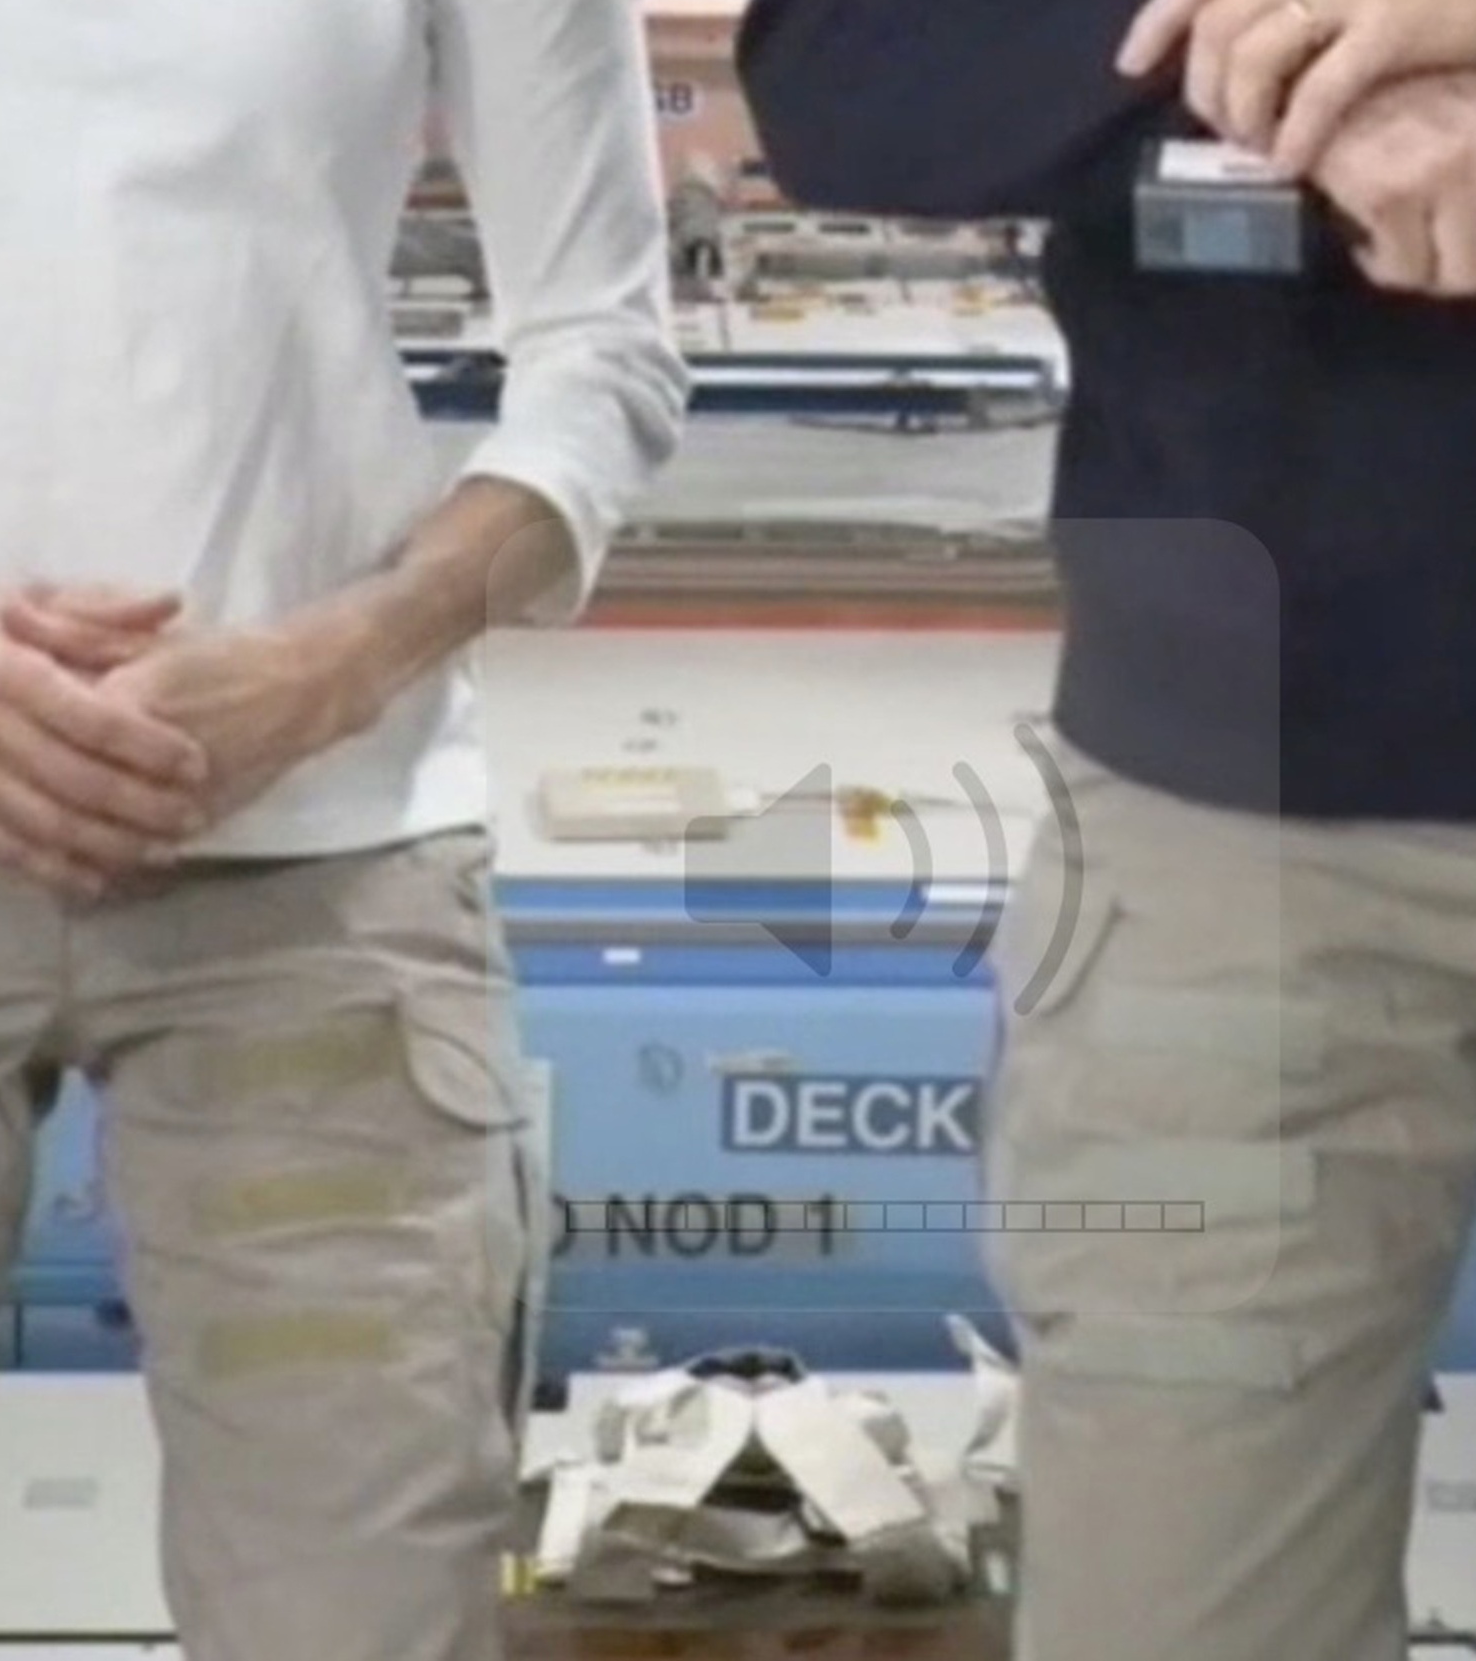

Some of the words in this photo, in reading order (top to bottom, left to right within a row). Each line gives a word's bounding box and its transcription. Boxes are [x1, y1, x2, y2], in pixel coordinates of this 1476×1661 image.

[732, 1080, 973, 1149] DECK
[606, 1191, 776, 1257] NOD
[809, 1193, 836, 1256] 1
